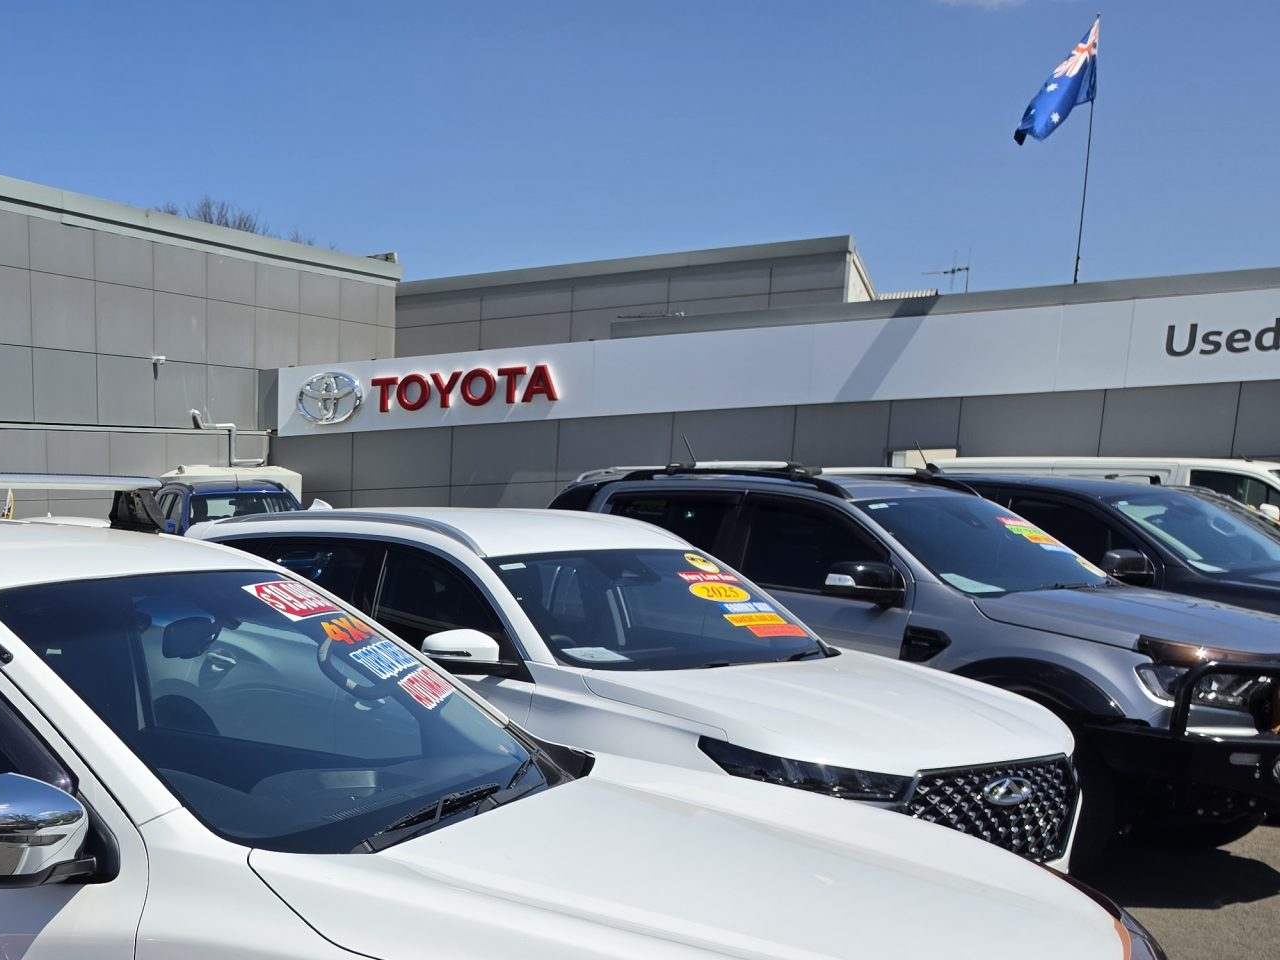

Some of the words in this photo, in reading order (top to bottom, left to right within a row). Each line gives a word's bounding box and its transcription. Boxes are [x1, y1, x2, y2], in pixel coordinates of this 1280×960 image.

[1165, 317, 1280, 357] Used
[371, 365, 559, 413] TOYOTA
[701, 586, 740, 598] 2025
